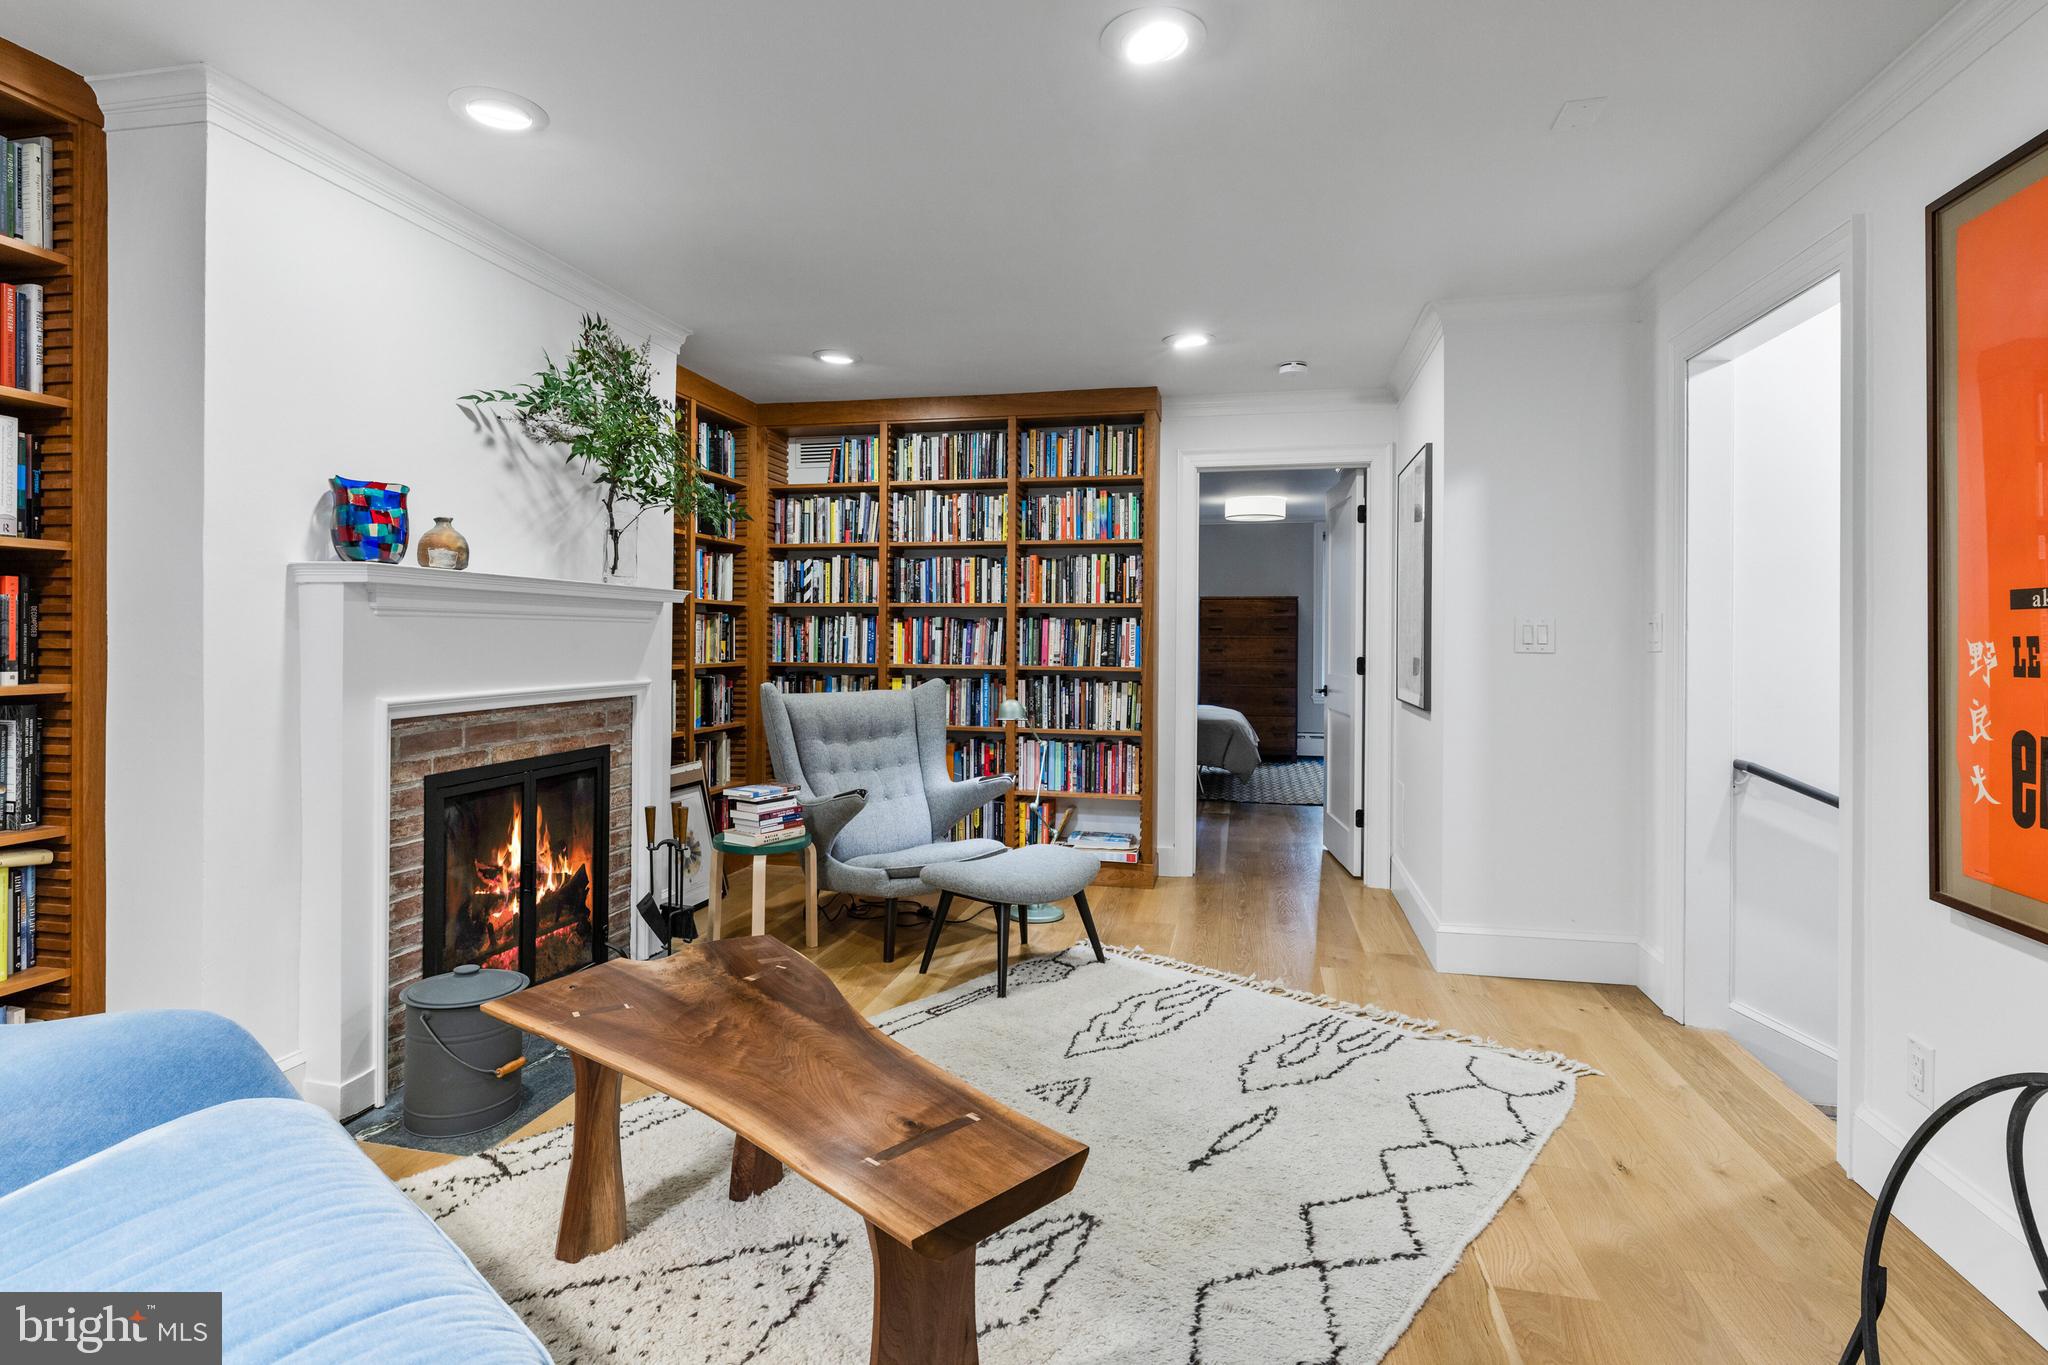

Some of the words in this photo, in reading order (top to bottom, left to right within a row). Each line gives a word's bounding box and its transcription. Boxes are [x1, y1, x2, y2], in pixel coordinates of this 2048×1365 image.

[6, 153, 14, 184] FURIOUS
[30, 605, 38, 638] DECOMPOSED
[2012, 635, 2041, 679] LE
[1966, 638, 2002, 805] 野良犬
[29, 908, 36, 917] TO
